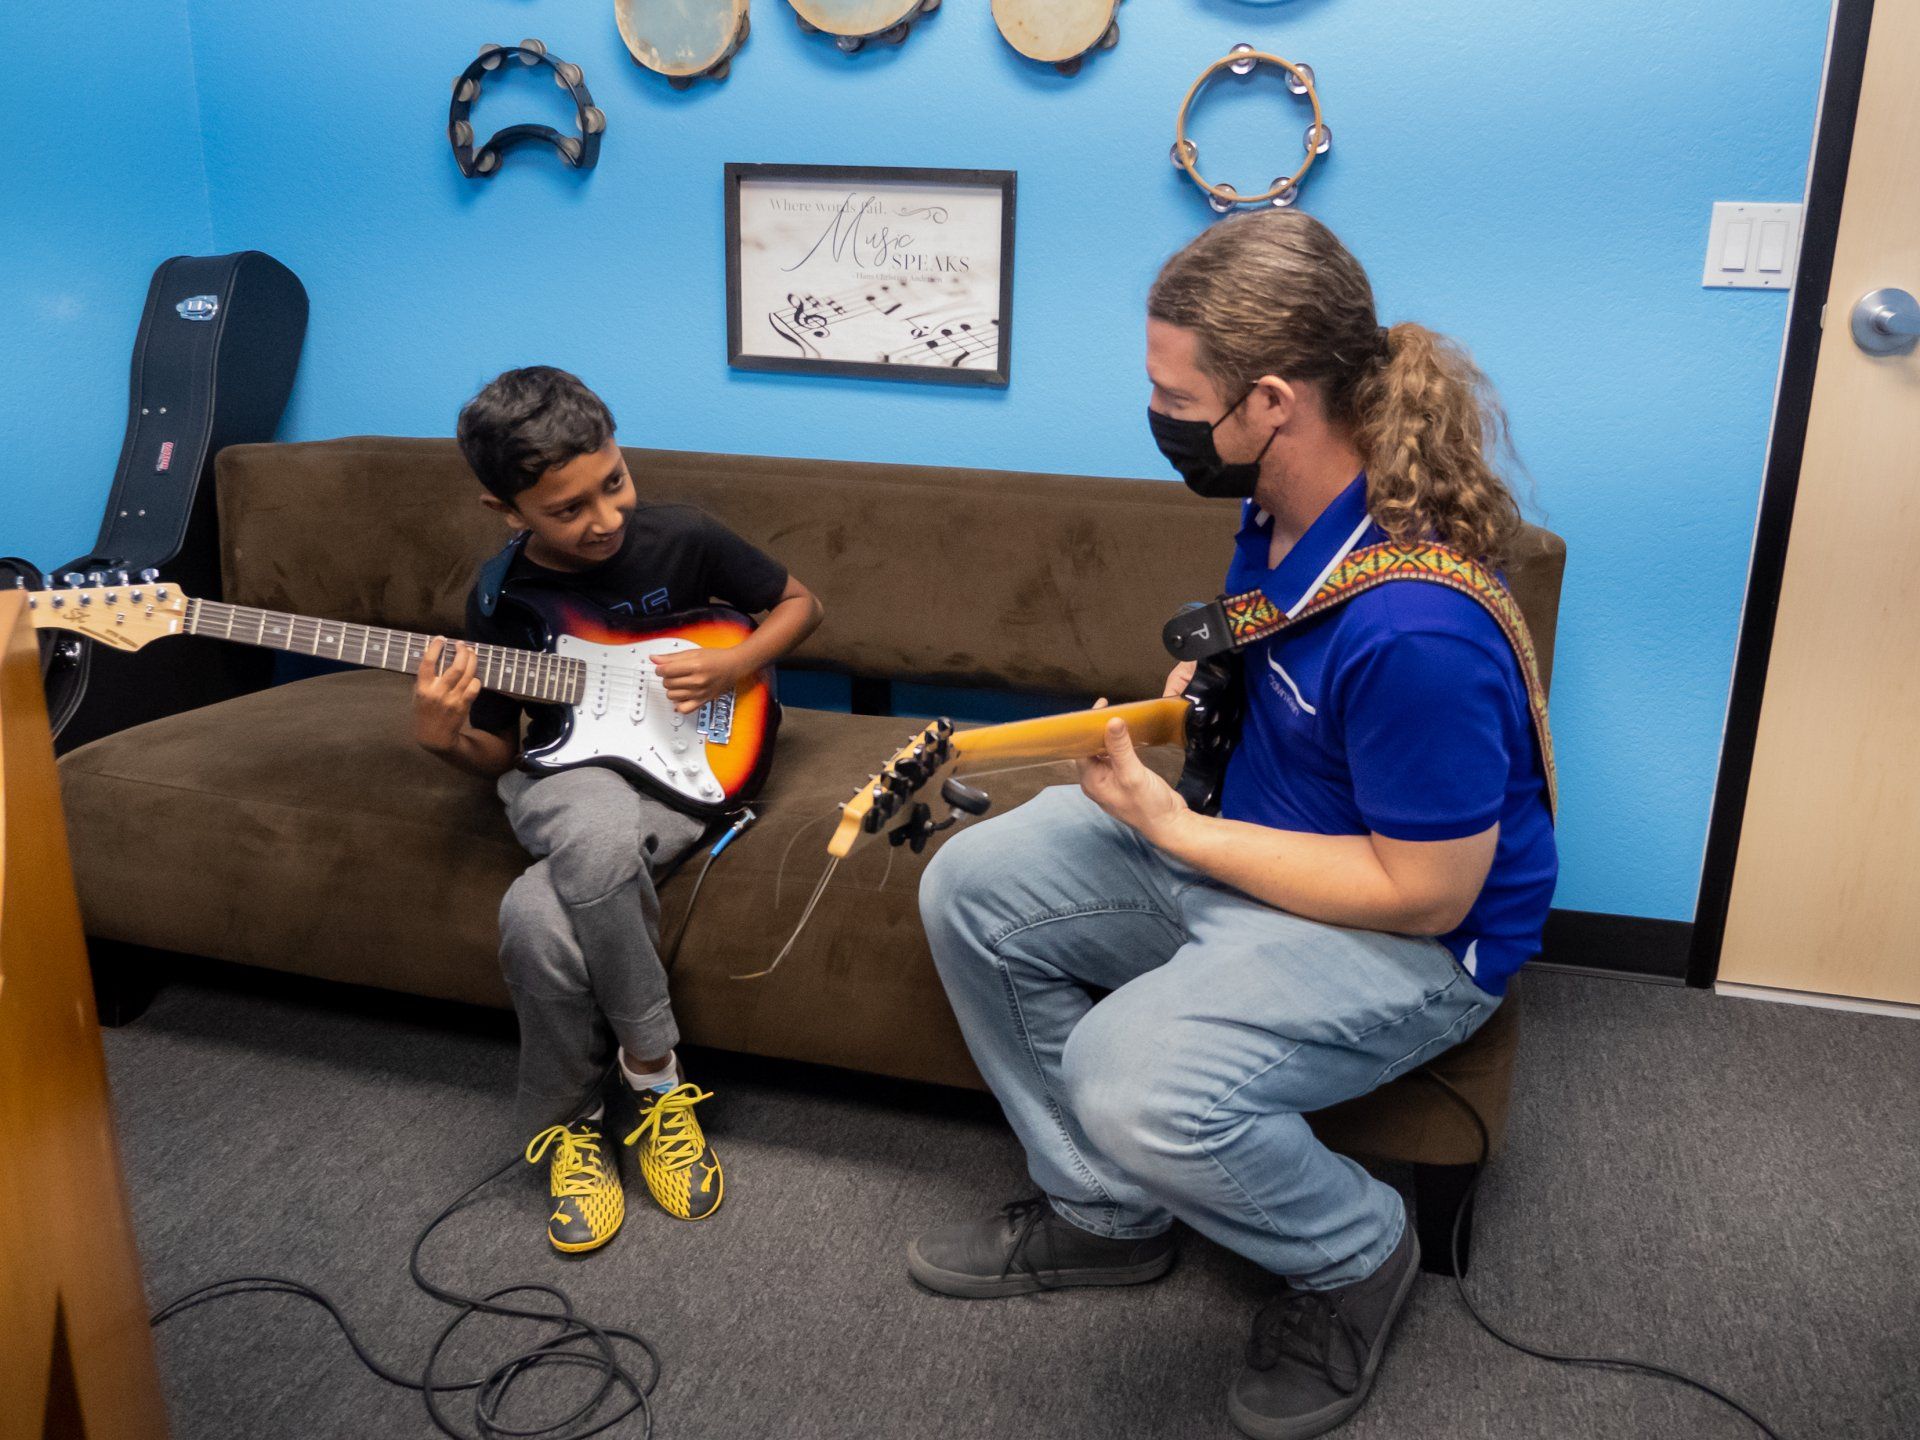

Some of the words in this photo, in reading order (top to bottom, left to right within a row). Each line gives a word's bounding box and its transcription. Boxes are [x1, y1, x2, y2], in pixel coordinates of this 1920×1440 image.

[770, 198, 812, 212] Where
[815, 200, 856, 214] words
[781, 193, 915, 272] Music
[892, 254, 969, 272] SPEAKS
